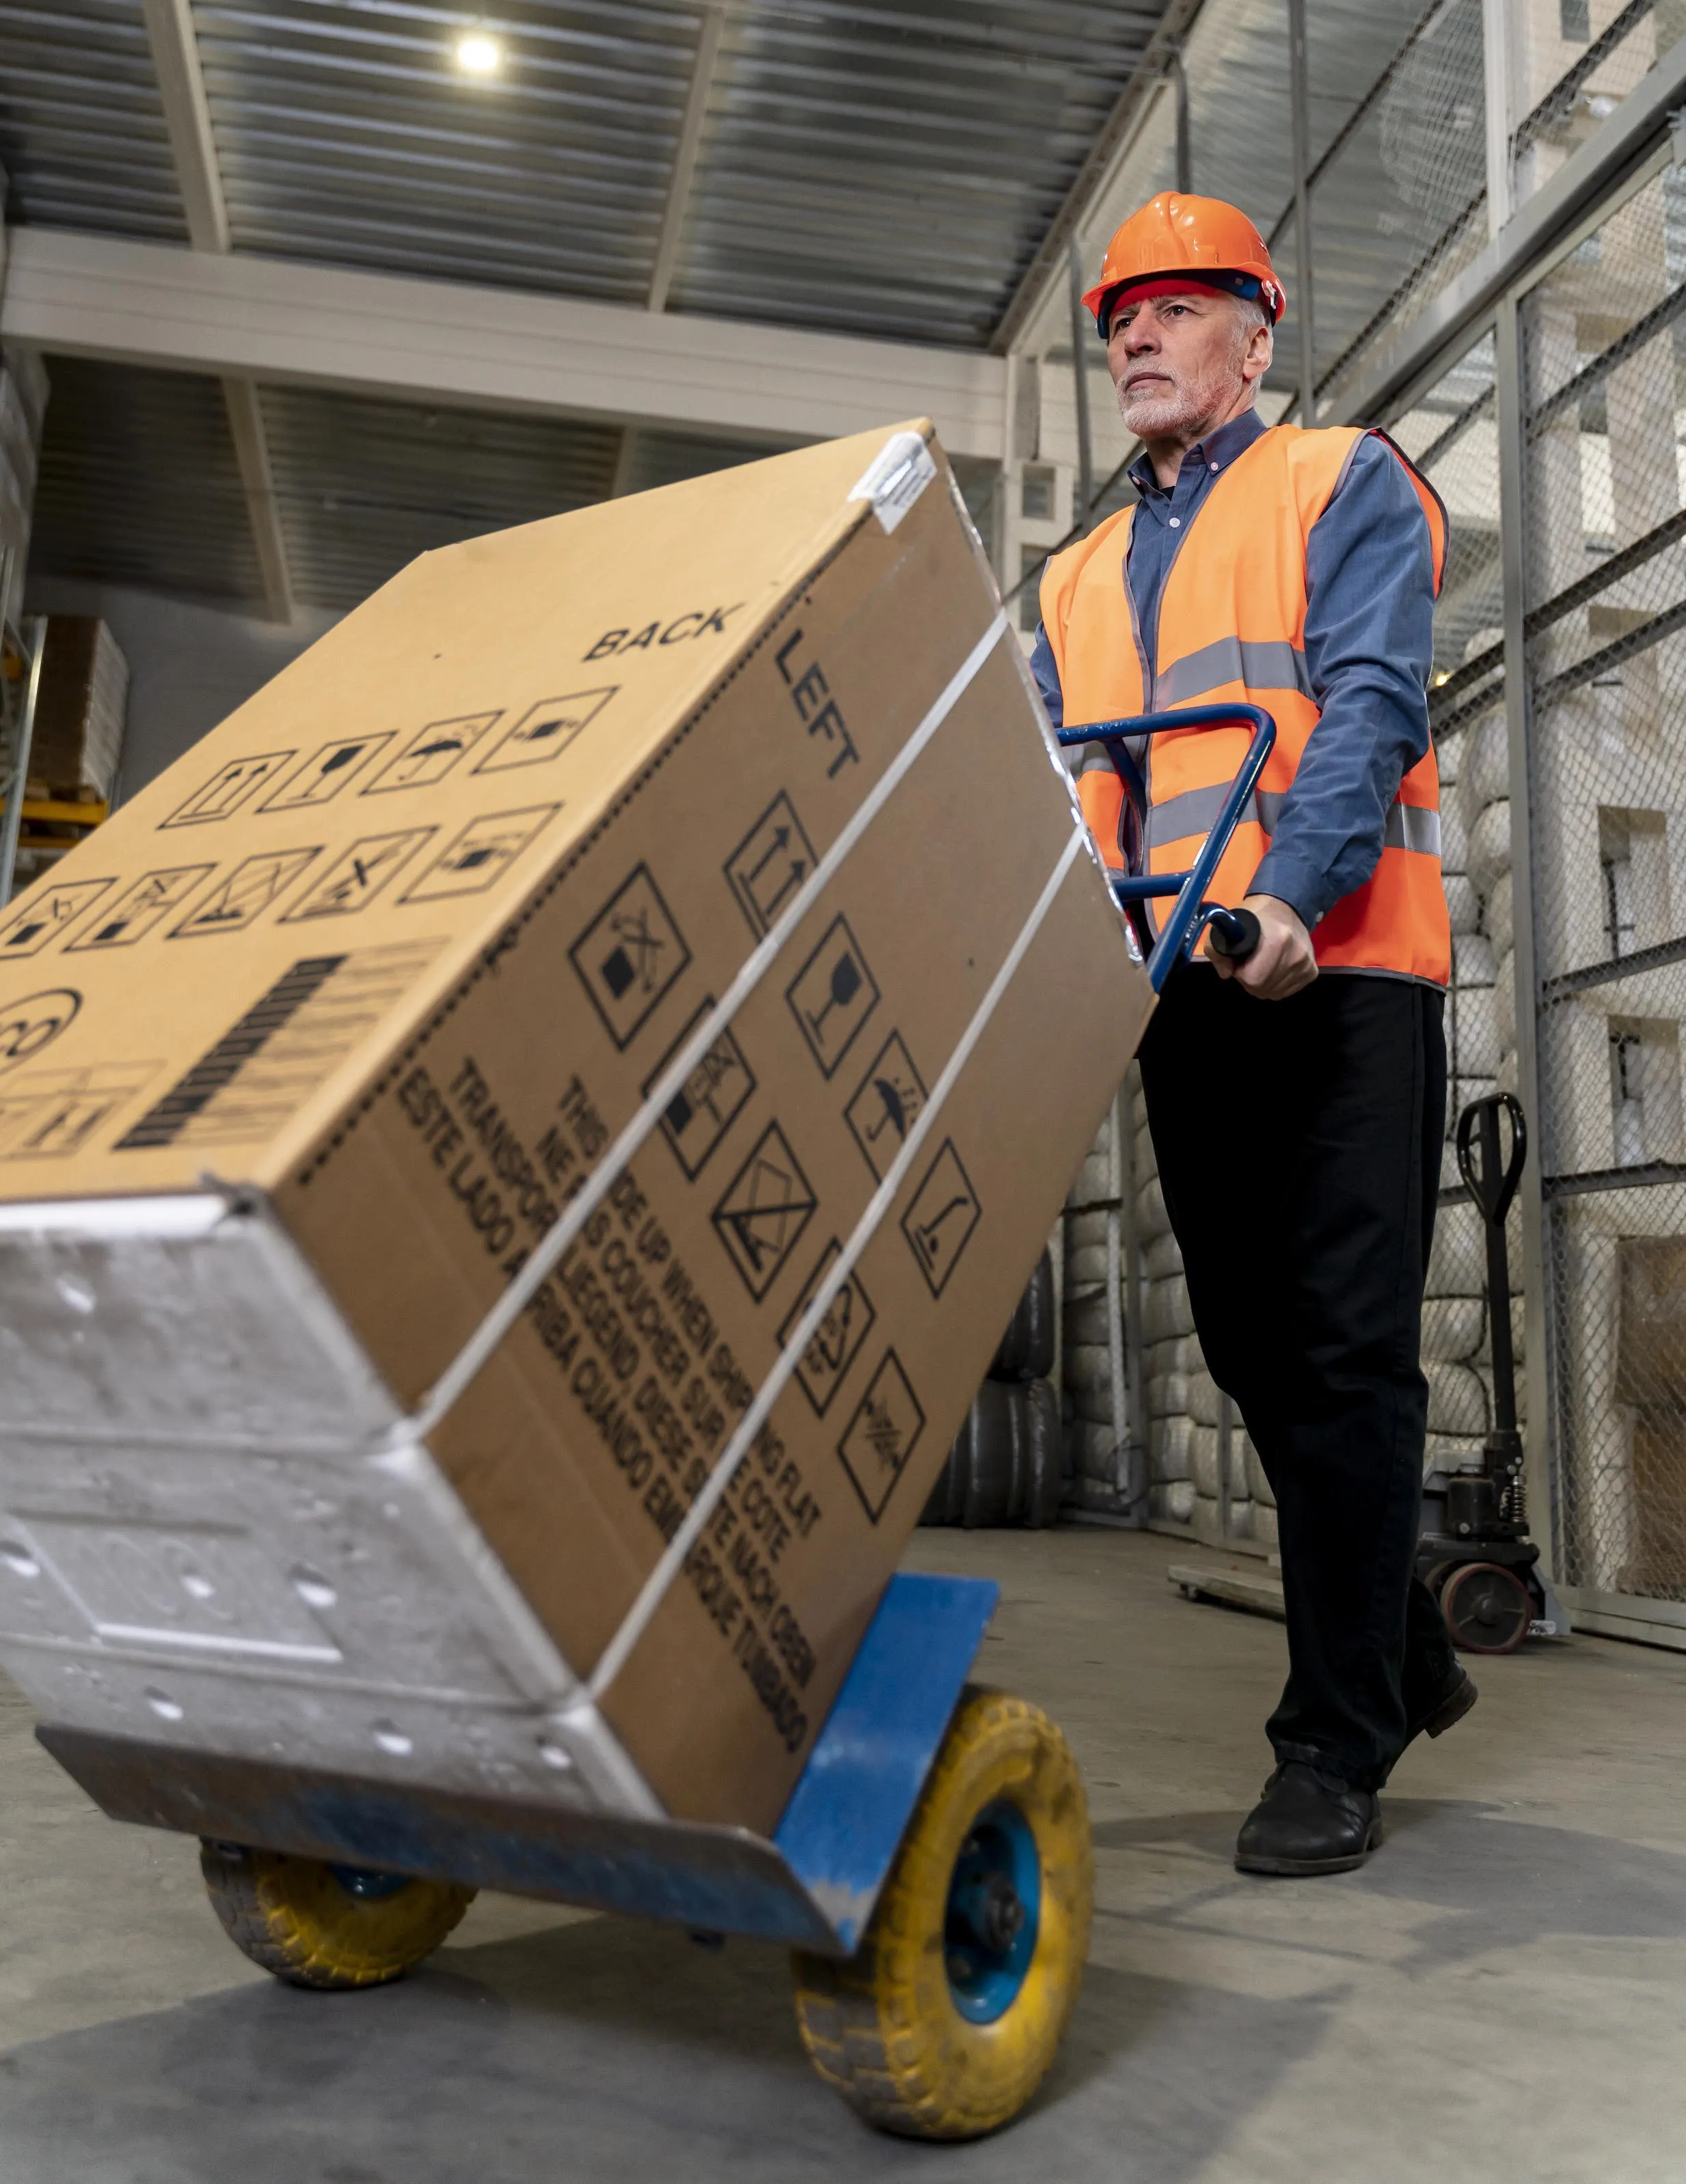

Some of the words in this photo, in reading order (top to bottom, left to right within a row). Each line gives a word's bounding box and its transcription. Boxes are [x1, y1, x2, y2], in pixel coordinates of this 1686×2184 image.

[581, 602, 746, 663] BACK
[774, 627, 859, 779] LEFT
[397, 1066, 463, 1168] ESTE
[448, 1153, 516, 1256] LADO
[501, 1244, 583, 1375] ARIBA
[571, 1356, 653, 1491] CUANDO
[642, 1471, 742, 1643] EMRQUE
[449, 1057, 560, 1245] TRANSPOR
[634, 1375, 693, 1473] DIESE
[681, 1448, 739, 1556] STE
[728, 1533, 779, 1621] NACH
[536, 1125, 575, 1185] NE
[562, 1168, 613, 1251] PS
[601, 1238, 690, 1387] COUCHER
[681, 1375, 725, 1451] SUR
[742, 1477, 791, 1564] COTE
[558, 1075, 608, 1161] THIS
[635, 1214, 672, 1273] UP
[661, 1259, 718, 1358] WHEN
[706, 1341, 786, 1485] SHIPNG
[774, 1459, 822, 1539] FLAT
